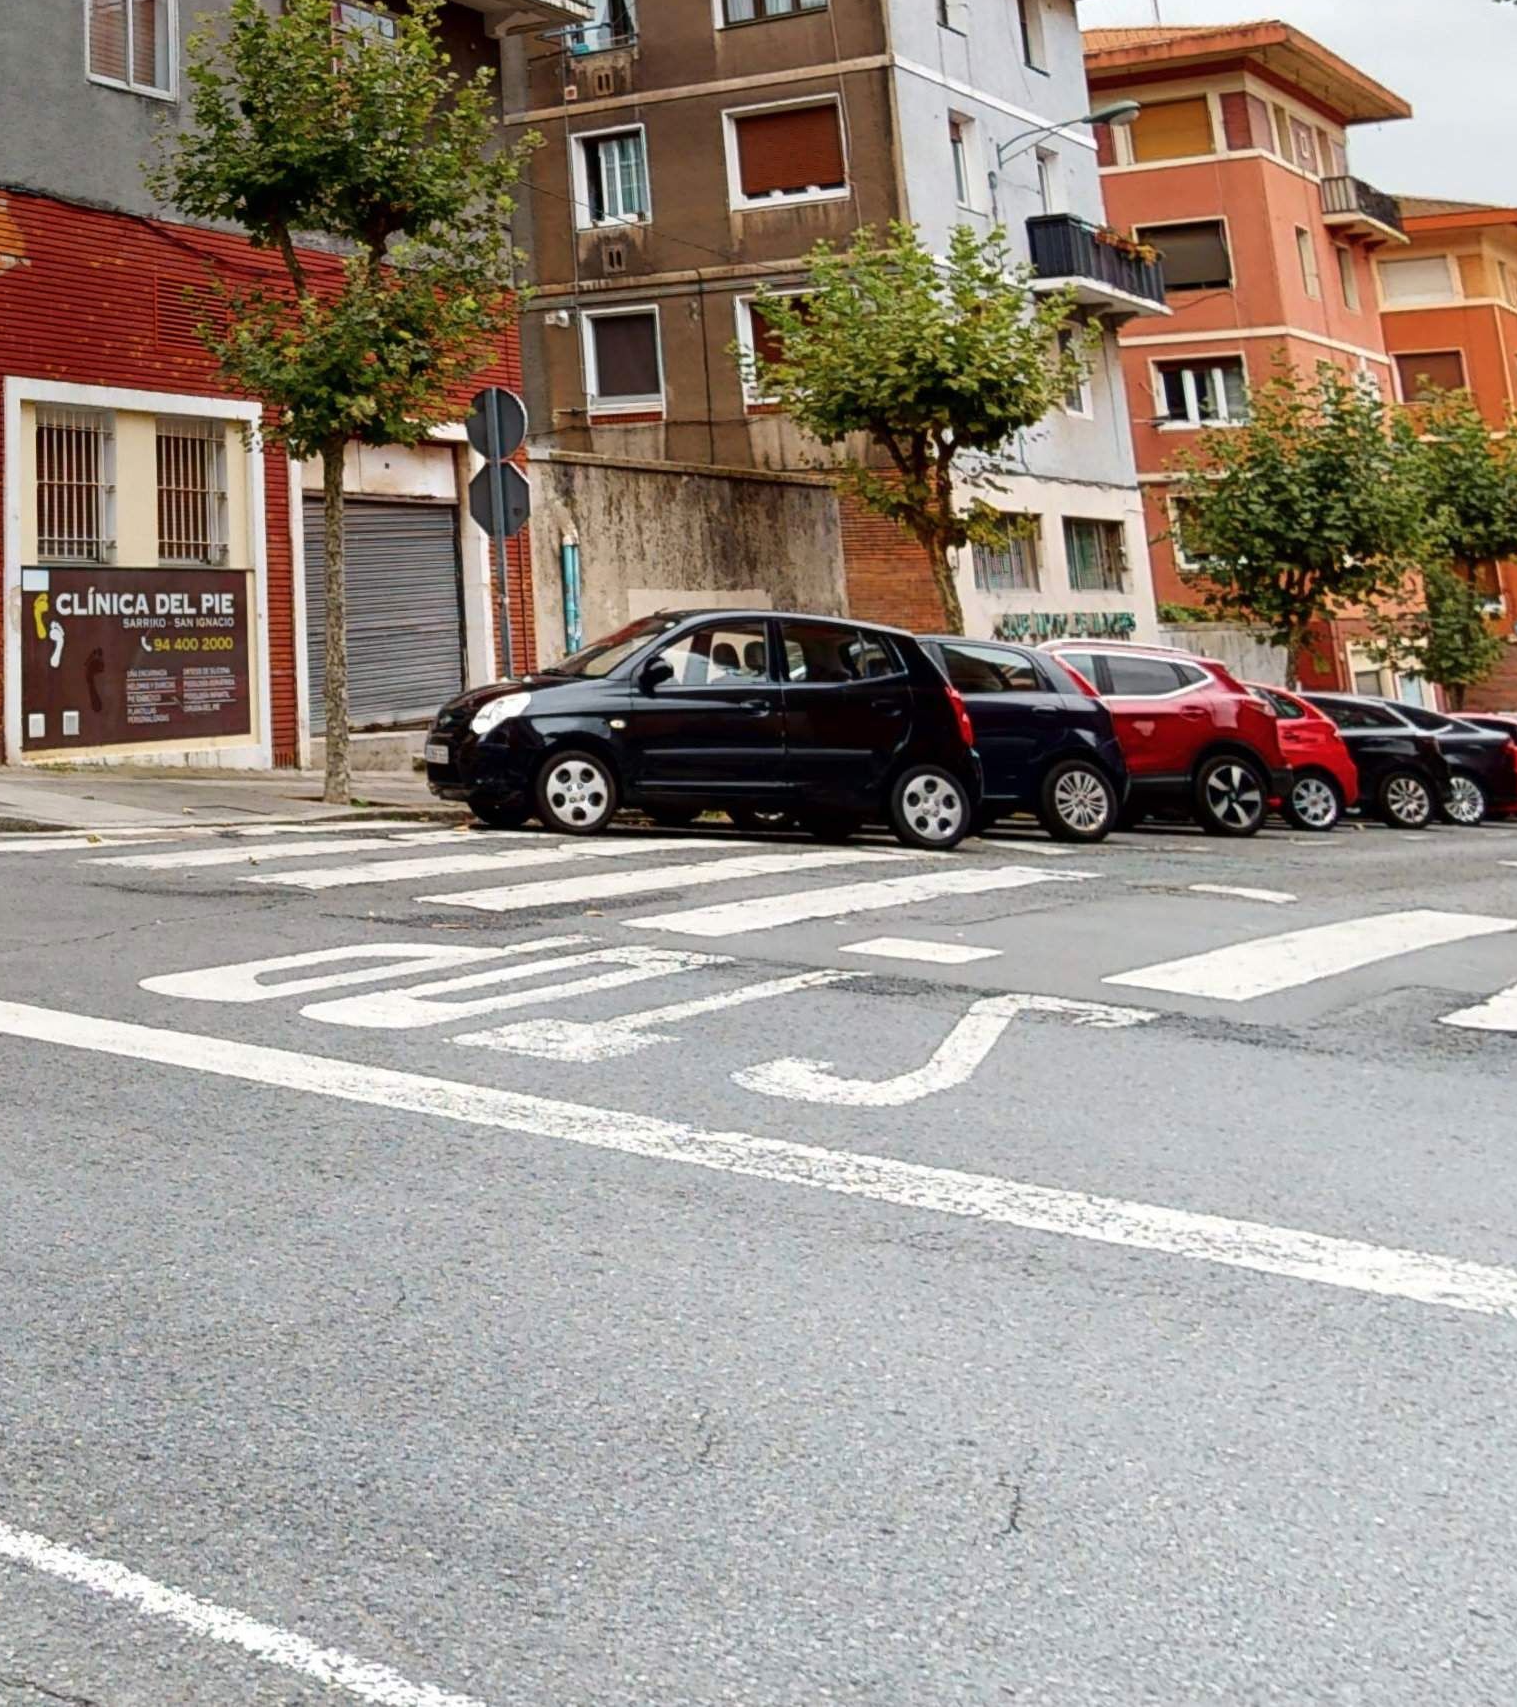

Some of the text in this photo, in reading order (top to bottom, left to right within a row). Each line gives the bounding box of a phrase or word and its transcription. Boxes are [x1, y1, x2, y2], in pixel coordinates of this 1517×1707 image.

[55, 586, 234, 615] CLÍNICA DEL PIE
[123, 617, 166, 628] SARRIKO
[174, 617, 194, 628] SAN
[196, 617, 234, 627] IGNACIO
[153, 637, 233, 651] 94 400 2000
